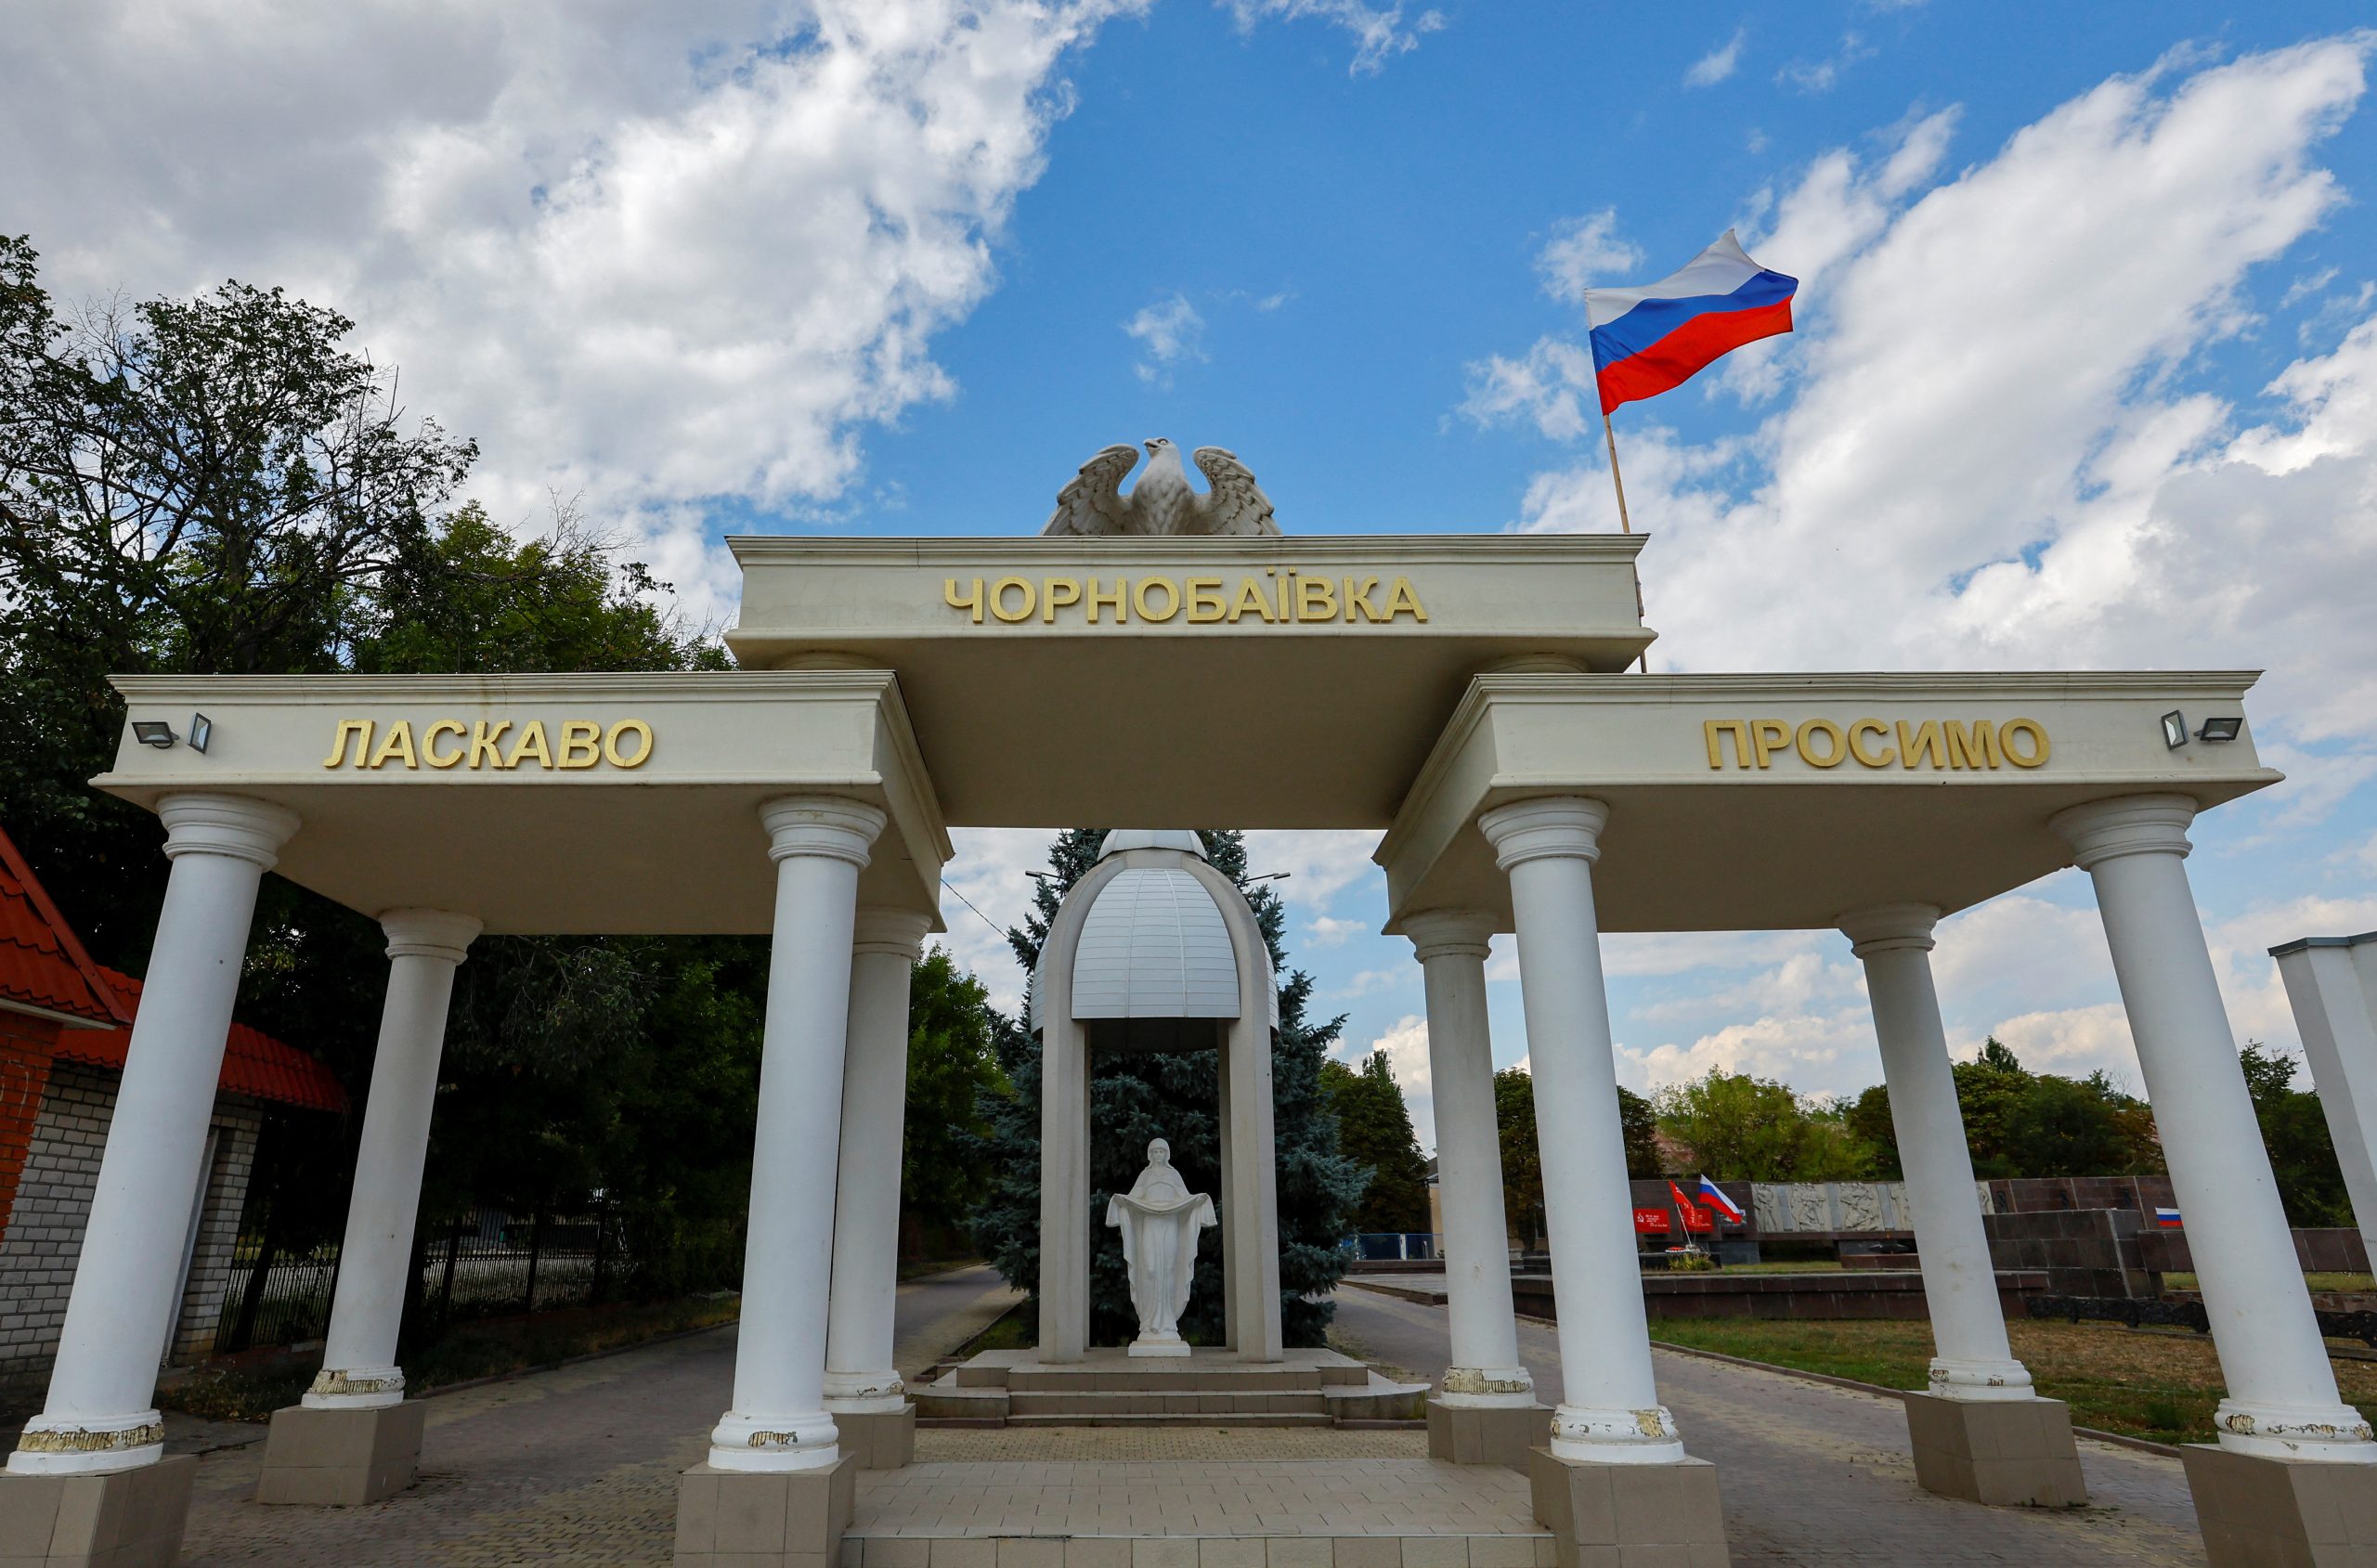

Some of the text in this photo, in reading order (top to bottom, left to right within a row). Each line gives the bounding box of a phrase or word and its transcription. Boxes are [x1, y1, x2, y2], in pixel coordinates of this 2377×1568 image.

[944, 566, 1428, 624] ЧОРНОБАЇВКА
[322, 719, 654, 769] ЛАСКАВО
[1704, 718, 2050, 770] ПРОСИМО
